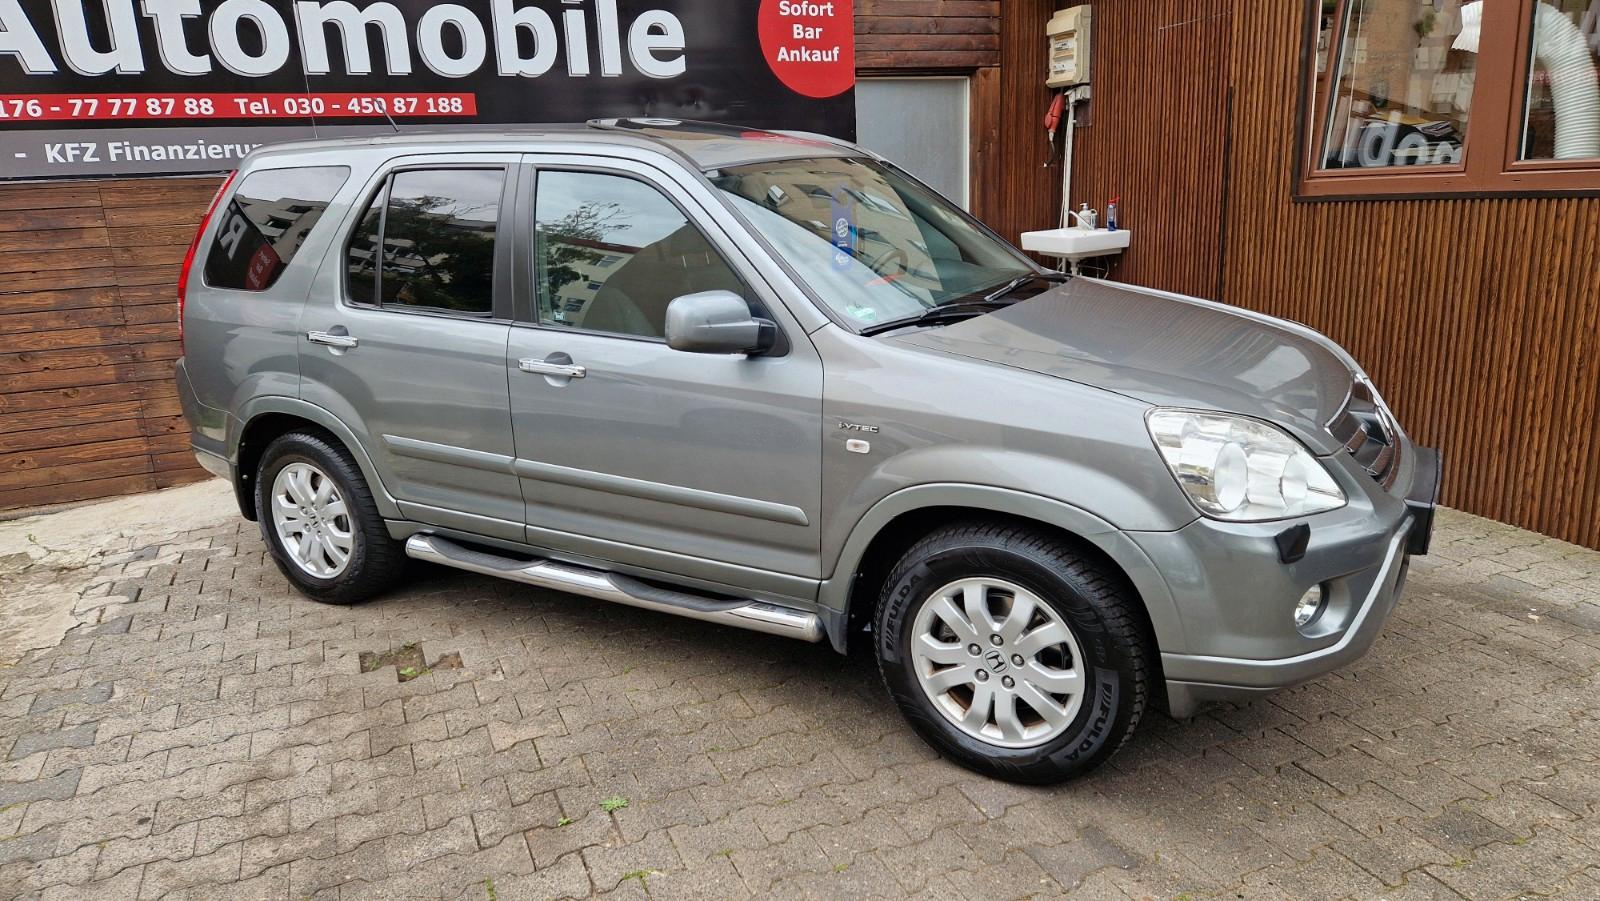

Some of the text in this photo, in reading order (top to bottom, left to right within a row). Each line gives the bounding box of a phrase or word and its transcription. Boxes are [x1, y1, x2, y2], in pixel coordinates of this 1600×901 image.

[779, 0, 834, 17] Sofort
[792, 23, 823, 40] Bar
[777, 46, 840, 62] Ankauf
[67, 98, 98, 116] 77
[107, 98, 137, 115] 77
[146, 98, 175, 115] 87
[184, 98, 215, 115] 88
[234, 97, 277, 115] Tel.
[284, 97, 325, 115] 030
[347, 97, 387, 114] 450
[393, 97, 418, 113] 87
[426, 97, 463, 113] 188
[44, 142, 100, 163] KFZ
[107, 139, 263, 161] Finanzieru
[887, 574, 921, 629] FULDA
[1063, 704, 1111, 760] FULDA
